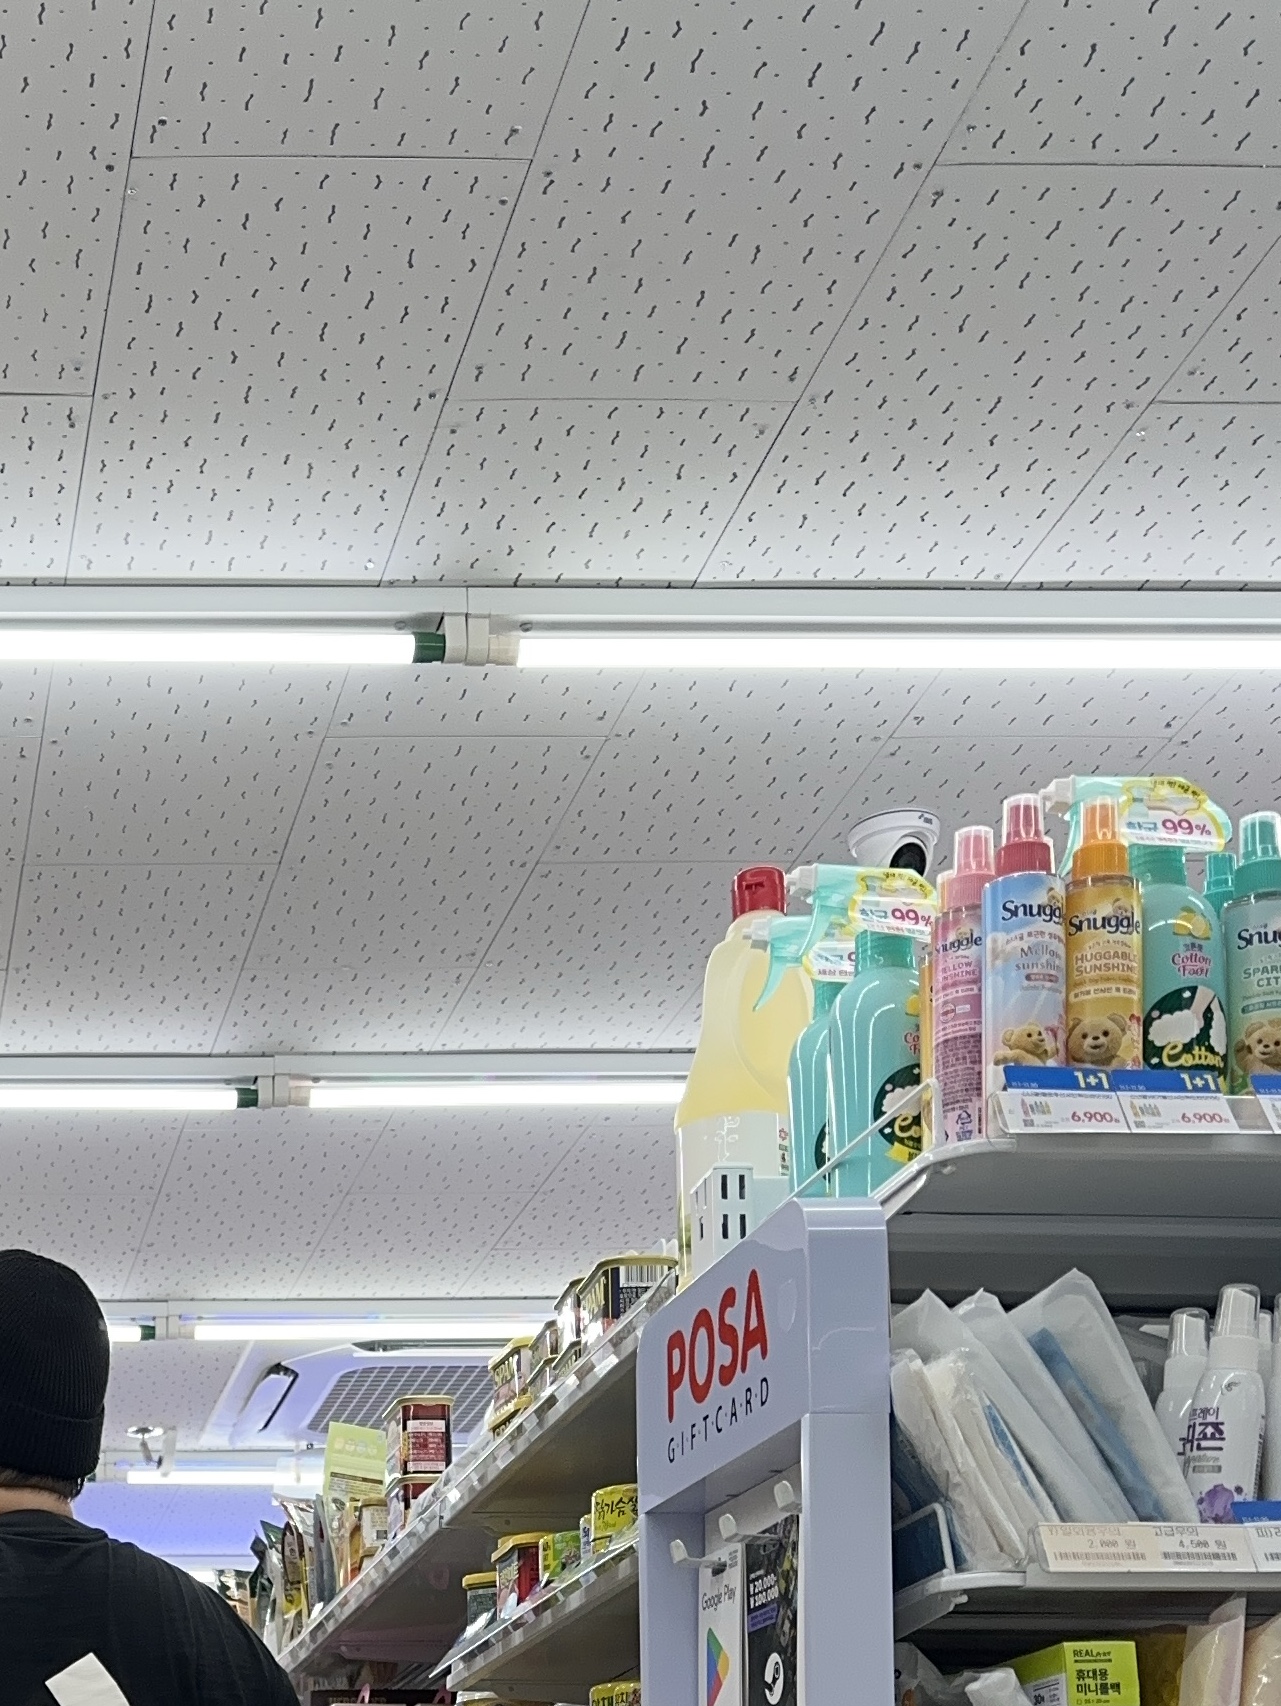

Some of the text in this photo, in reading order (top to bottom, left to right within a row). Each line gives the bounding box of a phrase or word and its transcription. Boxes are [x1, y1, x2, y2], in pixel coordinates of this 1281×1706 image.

[1068, 911, 1141, 937] Snuggle
[1073, 1071, 1110, 1090] 1+1
[1180, 1073, 1216, 1091] 1+1
[1071, 1110, 1113, 1125] 6,900
[1181, 1111, 1223, 1126] 6,900
[666, 1268, 769, 1423] POSA
[702, 1584, 737, 1612] Google Play
[1073, 1649, 1097, 1658] REAL
[1075, 1668, 1109, 1682] 휴대용
